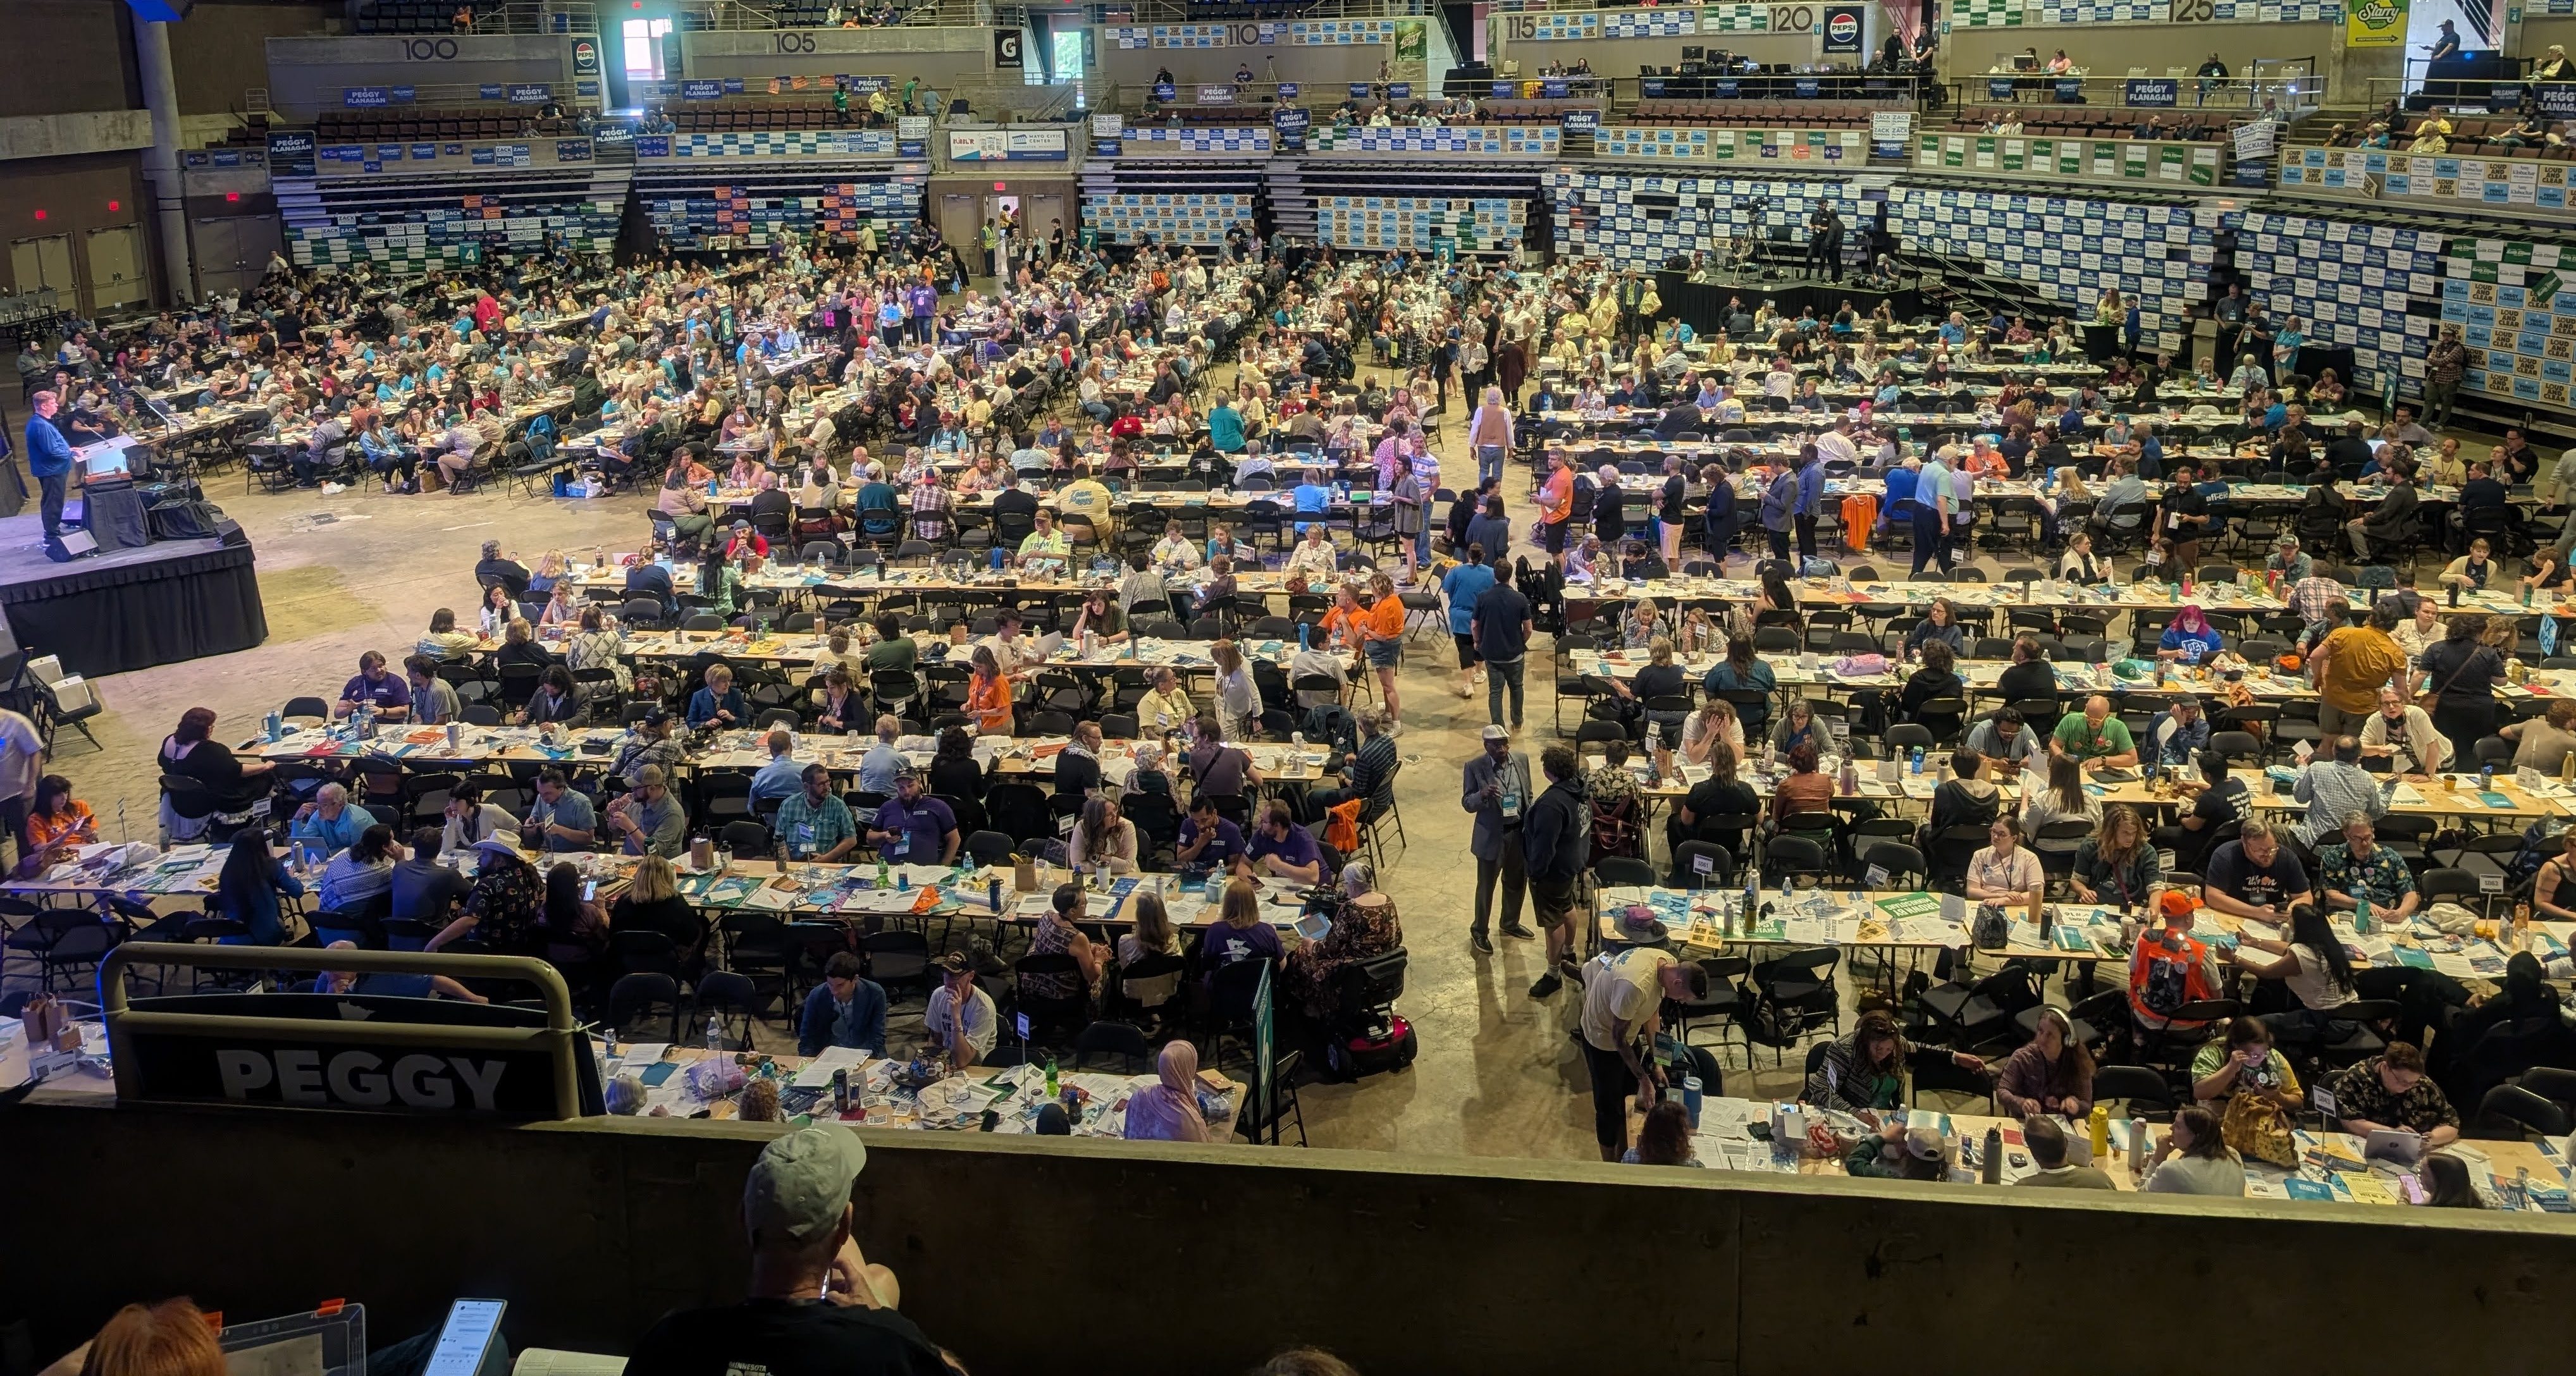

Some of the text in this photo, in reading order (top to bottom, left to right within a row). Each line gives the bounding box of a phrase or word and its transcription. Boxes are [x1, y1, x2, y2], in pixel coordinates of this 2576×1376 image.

[2168, 0, 2215, 22] 125
[2357, 2, 2402, 24] Starry
[1770, 6, 1813, 32] 120
[1226, 23, 1259, 46] 110
[1506, 16, 1536, 39] 115
[402, 39, 459, 60] 100
[773, 32, 817, 53] 105
[1001, 37, 1017, 58] G
[2135, 85, 2168, 93] PEGGY
[2235, 127, 2256, 137] ZACK
[271, 144, 312, 152] FLANAGAN
[1084, 235, 1093, 249] 7
[465, 249, 476, 262] 4
[1439, 247, 1449, 261] 3
[2500, 309, 2519, 317] LOUD
[724, 318, 730, 336] 8
[2489, 384, 2510, 393] CLEAR
[2546, 383, 2565, 391] LOUD
[2386, 384, 2393, 408] 2
[2544, 394, 2566, 403] CLEAR
[1068, 496, 1094, 506] Peggy
[1030, 540, 1051, 550] IBEW
[2235, 804, 2253, 820] 26
[1670, 897, 1688, 916] TAX
[1884, 897, 1933, 911] MINNESOTANS
[1896, 902, 1941, 917] GROWN BY
[216, 1050, 506, 1112] PEGGY
[729, 1361, 767, 1372] MINNESOTA
